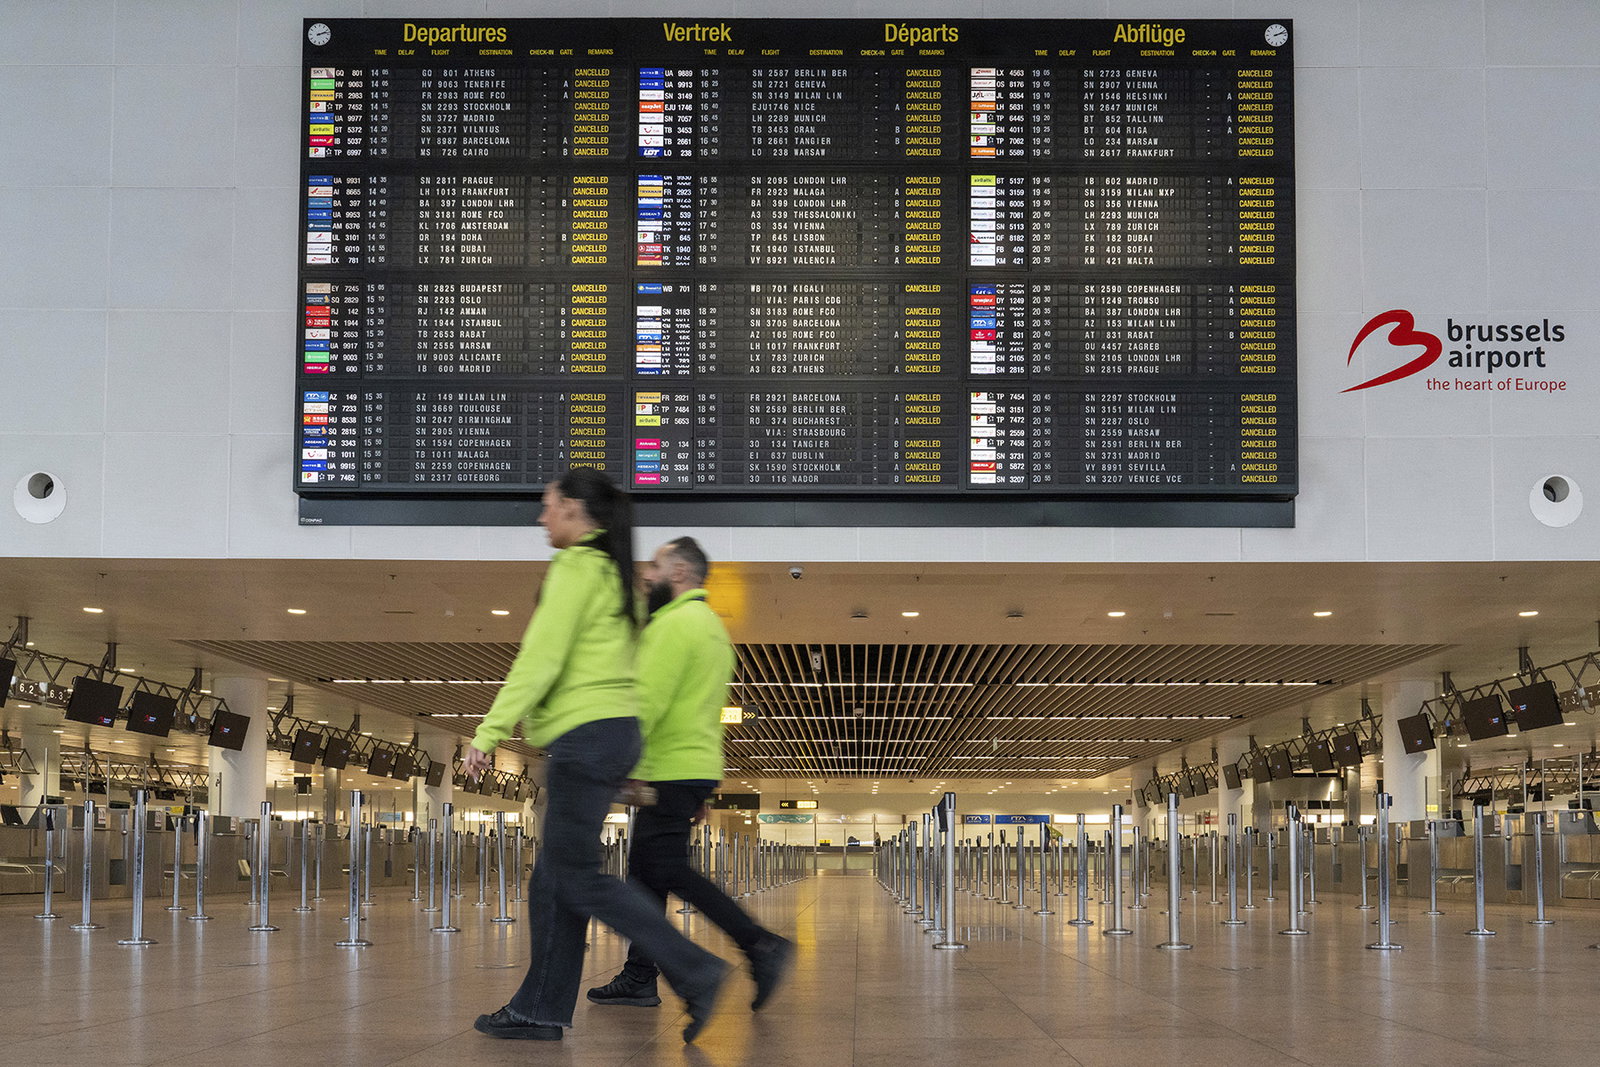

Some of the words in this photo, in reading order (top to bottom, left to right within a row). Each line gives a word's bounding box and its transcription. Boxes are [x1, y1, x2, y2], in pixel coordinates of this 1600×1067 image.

[403, 23, 507, 45] Departures
[663, 23, 732, 42] Vertrek
[885, 23, 958, 46] Départs
[1113, 24, 1185, 46] Abflüge
[560, 48, 572, 56] GATE
[464, 69, 494, 77] ATHENS
[795, 69, 826, 77] BERLIN
[832, 69, 847, 77] BER
[1126, 69, 1157, 78] GENEVA
[465, 80, 505, 88] TENERIFE
[795, 80, 825, 89] GENEVA
[1127, 81, 1157, 89] VIENNA
[1238, 81, 1273, 89] CANCELLED
[464, 91, 483, 100] ROME
[491, 91, 505, 100] FCO
[795, 91, 820, 100] MILAN
[827, 91, 841, 100] LIN
[1127, 92, 1167, 101] HELSINKI
[438, 103, 457, 111] 2293
[464, 102, 510, 111] STOCKHOLM
[795, 103, 814, 111] NICE
[907, 103, 941, 111] CANCELLED
[1126, 103, 1157, 112] MUNICH
[464, 114, 494, 122] MADRID
[795, 114, 825, 122] MUNICH
[1128, 115, 1163, 123] TALLINN
[464, 125, 499, 134] VILNIUS
[574, 125, 608, 133] CANCELLED
[795, 125, 814, 134] ORAN
[1127, 126, 1146, 134] RIGA
[463, 137, 509, 145] BARCELONA
[796, 137, 830, 145] TANGIER
[1127, 137, 1157, 146] WARSAW
[463, 148, 488, 156] CAIRO
[1127, 149, 1172, 157] FRANKFURT
[463, 176, 493, 185] PRAGUE
[574, 176, 608, 184] CANCELLED
[794, 176, 824, 185] LONDON
[831, 176, 846, 185] LHR
[1127, 177, 1158, 185] MADRID
[463, 187, 508, 196] FRANKFURT
[768, 188, 787, 196] 2923
[794, 188, 824, 196] MALAGA
[1101, 188, 1121, 197] 3159
[1127, 188, 1153, 197] MILAN
[1159, 188, 1174, 197] MXP
[462, 199, 492, 208] LONDON
[499, 199, 513, 207] LHR
[794, 199, 824, 208] LONDON
[831, 199, 846, 208] LHR
[462, 210, 481, 219] ROME
[489, 210, 503, 219] FCO
[794, 210, 855, 219] THESSALONIKI
[462, 222, 508, 230] AMSTERDAM
[794, 222, 824, 230] VIENNA
[906, 222, 941, 230] CANCELLED
[1128, 222, 1158, 231] ZURICH
[462, 233, 481, 241] DOHA
[794, 233, 824, 242] LISBON
[1128, 234, 1152, 242] DUBAI
[461, 244, 485, 253] DUBAI
[795, 245, 833, 253] ISTANBUL
[1128, 245, 1152, 254] SOFIA
[1240, 245, 1274, 253] CANCELLED
[462, 256, 491, 264] ZURICH
[794, 256, 835, 265] VALENCIA
[1128, 257, 1153, 265] MALTA
[461, 284, 501, 293] BUDAPEST
[794, 284, 823, 293] KIGALI
[1128, 285, 1180, 293] COPENHAGEN
[461, 296, 481, 304] OSLO
[794, 296, 819, 304] PARIS
[826, 296, 840, 305] CDG
[1128, 296, 1158, 305] TROMSO
[461, 307, 486, 315] AMMAN
[572, 307, 606, 315] CANCELLED
[793, 307, 813, 316] ROME
[820, 307, 834, 316] FCO
[906, 307, 940, 316] CANCELLED
[1128, 308, 1159, 316] LONDON
[1166, 308, 1180, 316] LHR
[435, 319, 453, 327] 1944
[462, 319, 500, 327] ISTANBUL
[767, 319, 787, 327] 3705
[793, 319, 840, 327] BARCELONA
[1128, 319, 1153, 328] MILAN
[1160, 319, 1175, 328] LIN
[1241, 319, 1275, 328] CANCELLED
[460, 330, 485, 338] RABAT
[793, 330, 813, 339] ROME
[820, 330, 835, 339] FCO
[1447, 318, 1565, 342] brussels
[1128, 331, 1152, 339] RABAT
[460, 341, 490, 350] WARSAW
[793, 342, 839, 350] FRANKFURT
[1129, 342, 1159, 351] ZAGREB
[460, 353, 500, 361] ALICANTE
[794, 353, 824, 362] ZURICH
[1129, 354, 1159, 362] LONDON
[1166, 354, 1180, 362] LHR
[1448, 343, 1546, 373] airport
[793, 365, 824, 373] ATHENS
[1128, 365, 1158, 374] PRAGUE
[1426, 378, 1450, 391] the
[1455, 378, 1493, 391] heart
[1497, 378, 1512, 391] of
[1515, 378, 1567, 393] Europe
[459, 393, 484, 401] MILAN
[491, 393, 506, 401] LIN
[793, 393, 840, 402] BARCELONA
[1128, 393, 1175, 402] STOCKHOLM
[460, 404, 500, 413] TOULOUSE
[571, 404, 605, 413] CANCELLED
[793, 405, 824, 414] BERLIN
[831, 405, 845, 414] BER
[1128, 405, 1154, 414] MILAN
[1161, 405, 1175, 414] LIN
[459, 416, 511, 424] BIRMINGHAM
[793, 416, 839, 425] BUCHAREST
[1102, 417, 1121, 426] 2287
[1129, 417, 1149, 425] OSLO
[459, 427, 489, 436] VIENNA
[793, 428, 845, 437] STRASBOURG
[459, 439, 510, 447] COPENHAGEN
[794, 440, 829, 448] TANGIER
[1129, 440, 1160, 448] BERLIN
[1166, 440, 1181, 448] BER
[1242, 440, 1276, 448] CANCELLED
[458, 450, 488, 459] MALAGA
[793, 451, 823, 460] DUBLIN
[906, 451, 940, 460] CANCELLED
[793, 463, 840, 472] STOCKHOLM
[1129, 463, 1165, 471] SEVILLA
[458, 473, 499, 482] GOTEBORG
[793, 474, 818, 483] NADOR
[1129, 475, 1159, 483] VENICE
[1167, 475, 1181, 483] VCE
[20, 683, 34, 695] 6.2
[50, 690, 63, 700] 6.3
